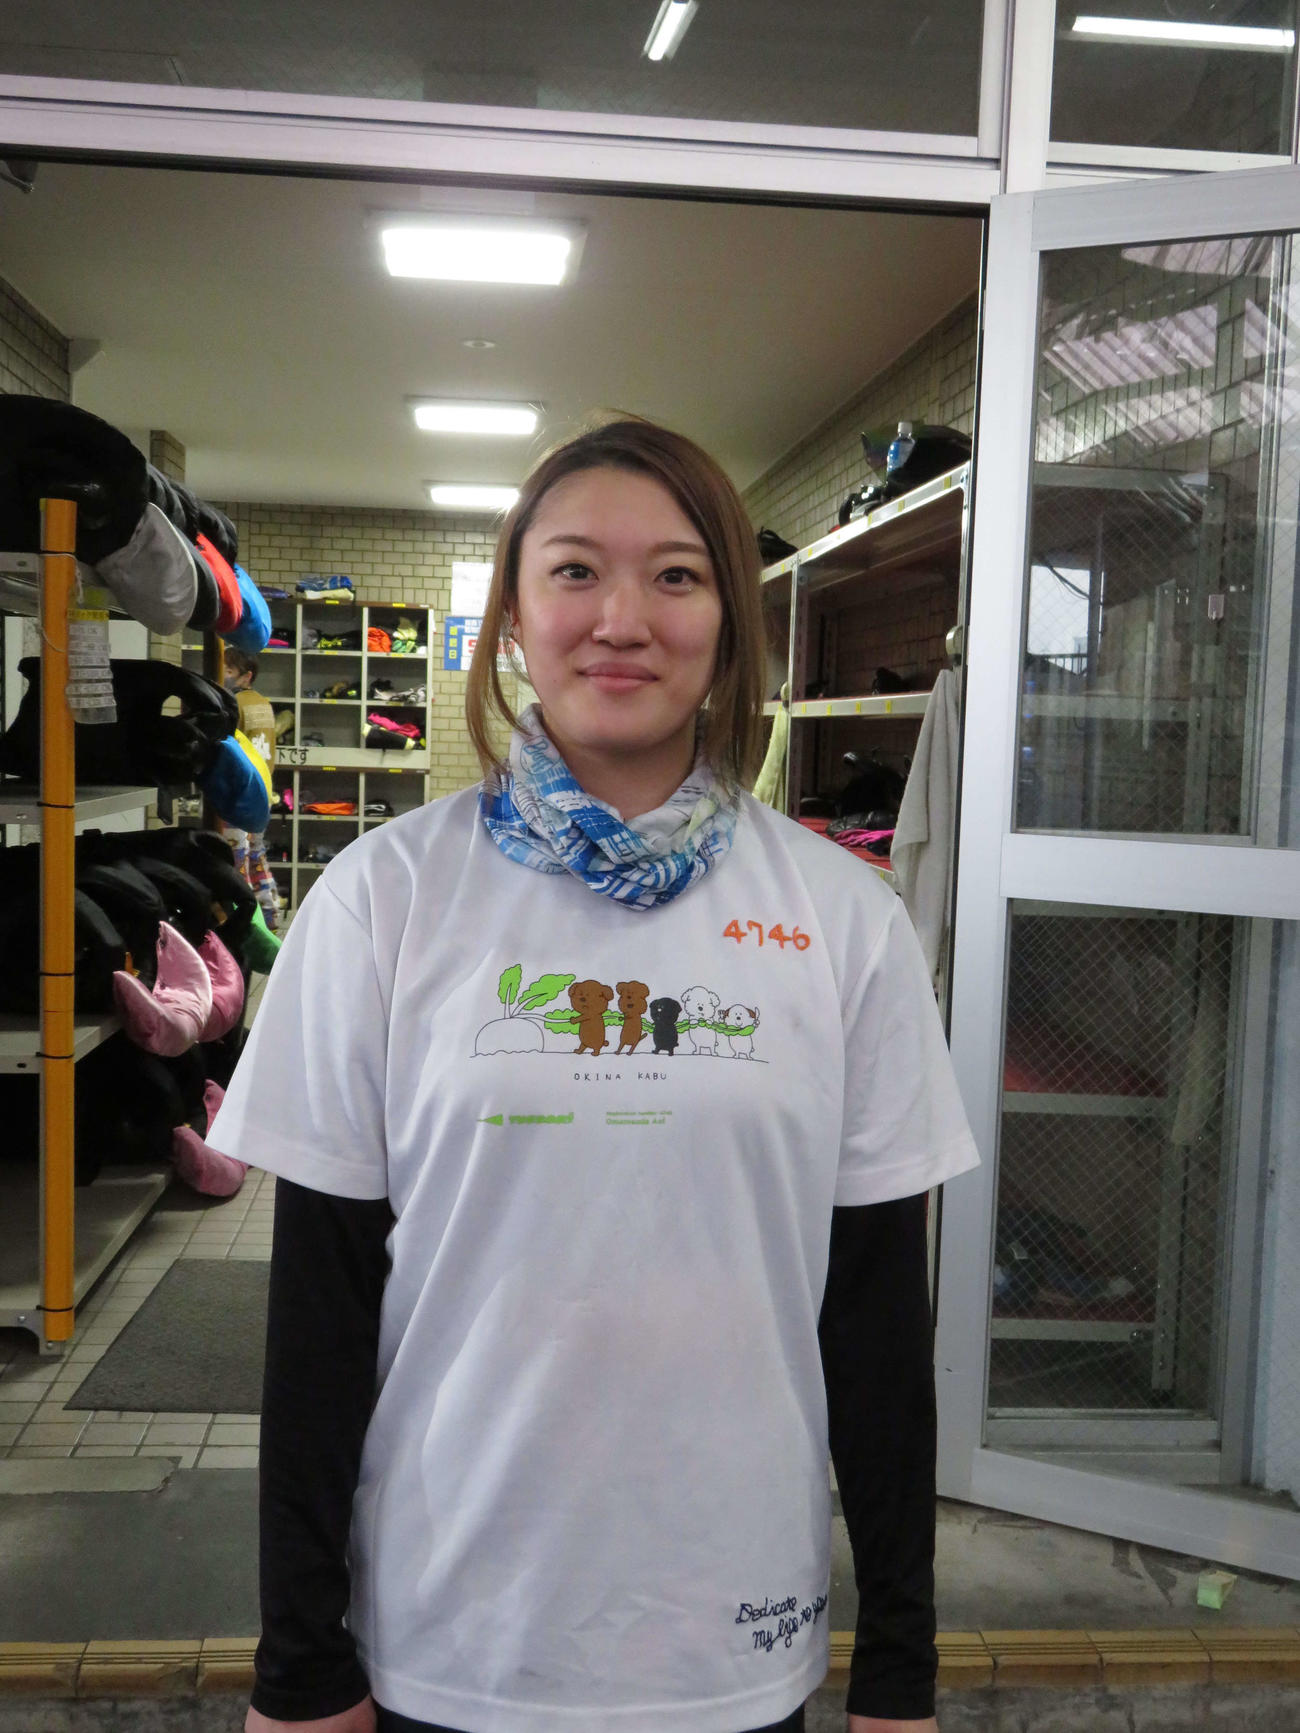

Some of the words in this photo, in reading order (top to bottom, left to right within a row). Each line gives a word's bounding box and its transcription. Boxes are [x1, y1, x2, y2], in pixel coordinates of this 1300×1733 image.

[723, 918, 811, 951] 4746
[573, 1072, 623, 1082] OKINA
[637, 1071, 668, 1081] KABU
[735, 1595, 798, 1625] Dedicate
